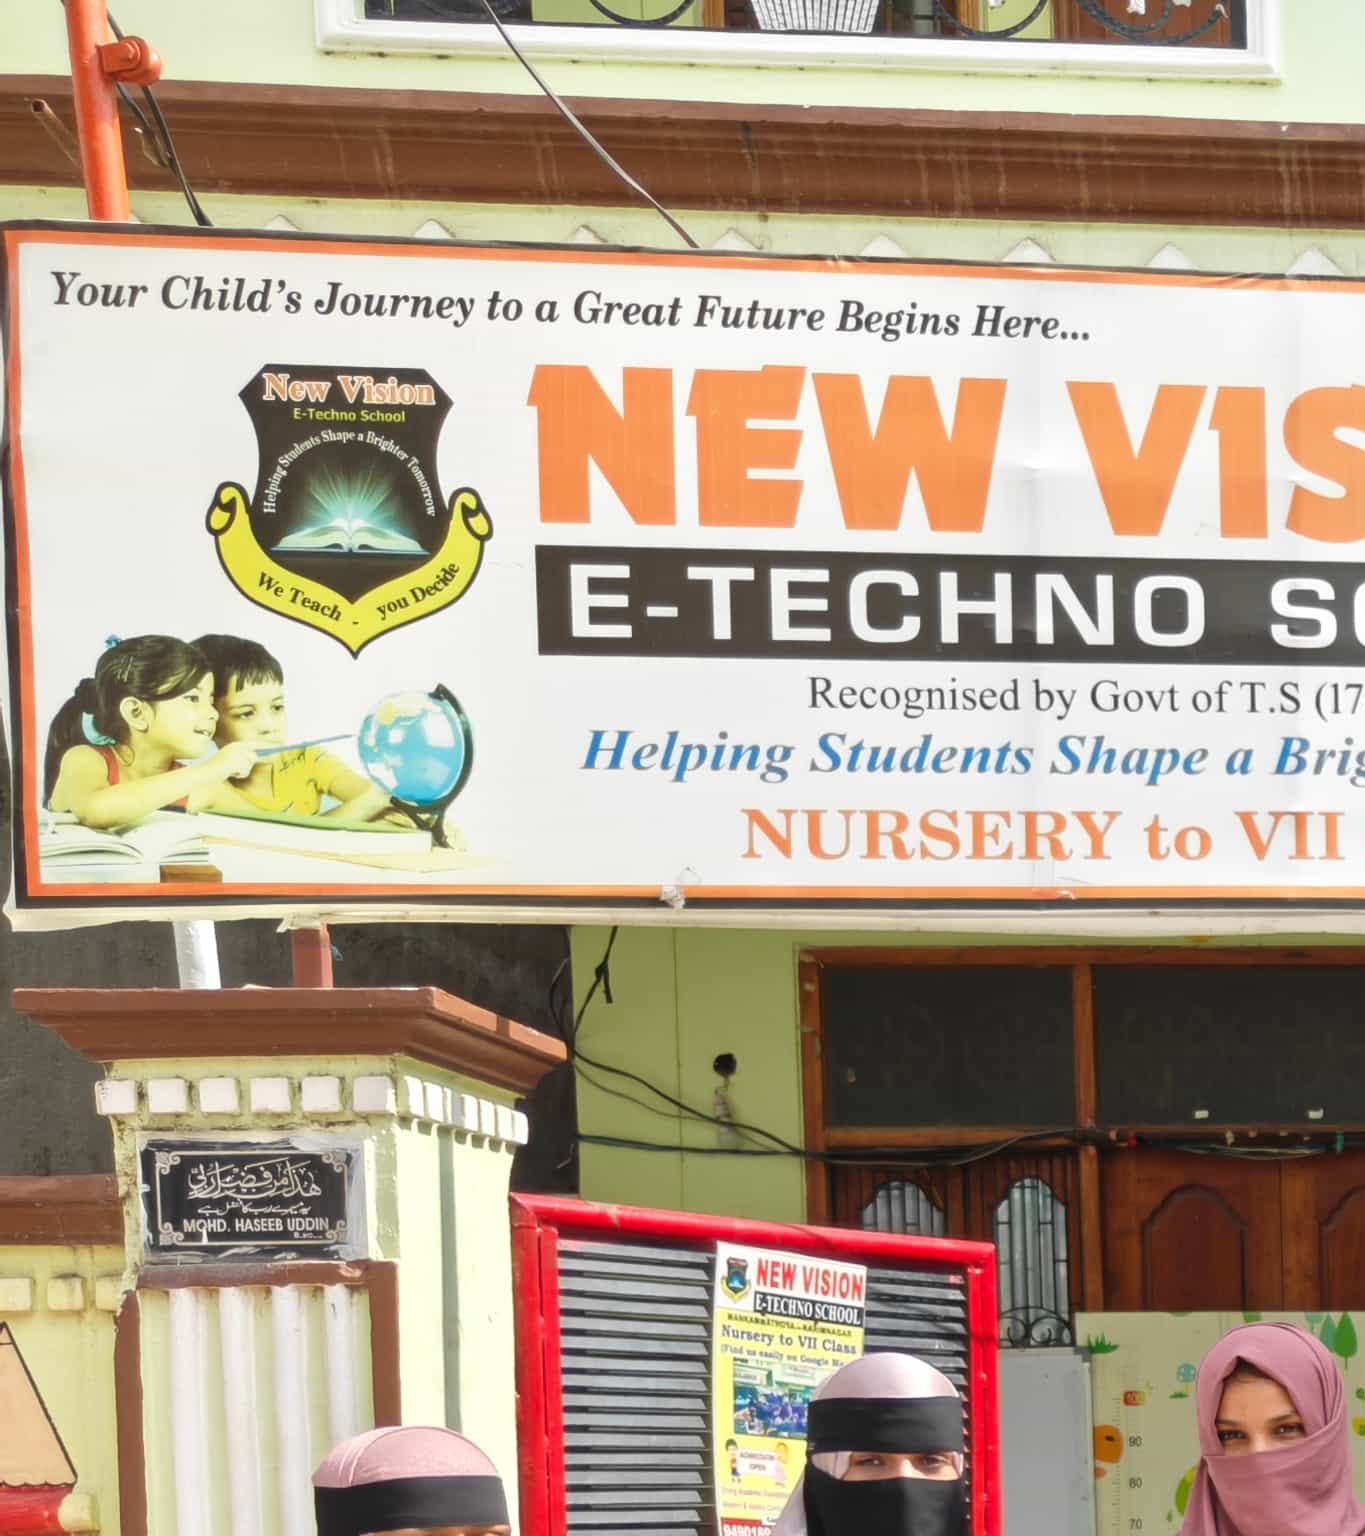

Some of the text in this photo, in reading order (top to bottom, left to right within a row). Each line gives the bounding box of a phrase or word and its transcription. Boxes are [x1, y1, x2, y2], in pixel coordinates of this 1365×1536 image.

[51, 271, 1090, 342] Your Child’s Journey to a Great Future Begins Here...
[263, 373, 436, 406] New Vision
[293, 407, 405, 423] E-Techno School
[527, 363, 1007, 534] NEW
[263, 428, 436, 517] Helping Students Shape a Brighter Tomorrow
[258, 571, 284, 597] We
[290, 586, 343, 622] Teach
[376, 597, 409, 621] you
[409, 561, 460, 603] Decide
[570, 562, 1206, 648] E-TECHNO
[808, 676, 1020, 719] Recognised
[1034, 680, 1077, 720] by
[1091, 681, 1178, 714] Govt
[1192, 681, 1229, 714] of
[1240, 682, 1301, 715] T.S
[580, 730, 796, 784] Helping
[809, 732, 1035, 775] Students
[1050, 735, 1208, 786] Shape
[1226, 749, 1252, 776] a
[741, 808, 1123, 861] NURSERY
[1144, 813, 1212, 861] to
[1234, 810, 1346, 861] VII
[183, 1217, 329, 1233] MOHD. HASEEB UDDIN
[756, 1258, 865, 1301] NEW VISION
[755, 1294, 861, 1325] E-TECHNO SCHOOL
[721, 1324, 857, 1355] Nursery to VII Class
[1128, 1436, 1143, 1447] 90
[1128, 1478, 1143, 1489] 80
[1128, 1519, 1143, 1530] 70
